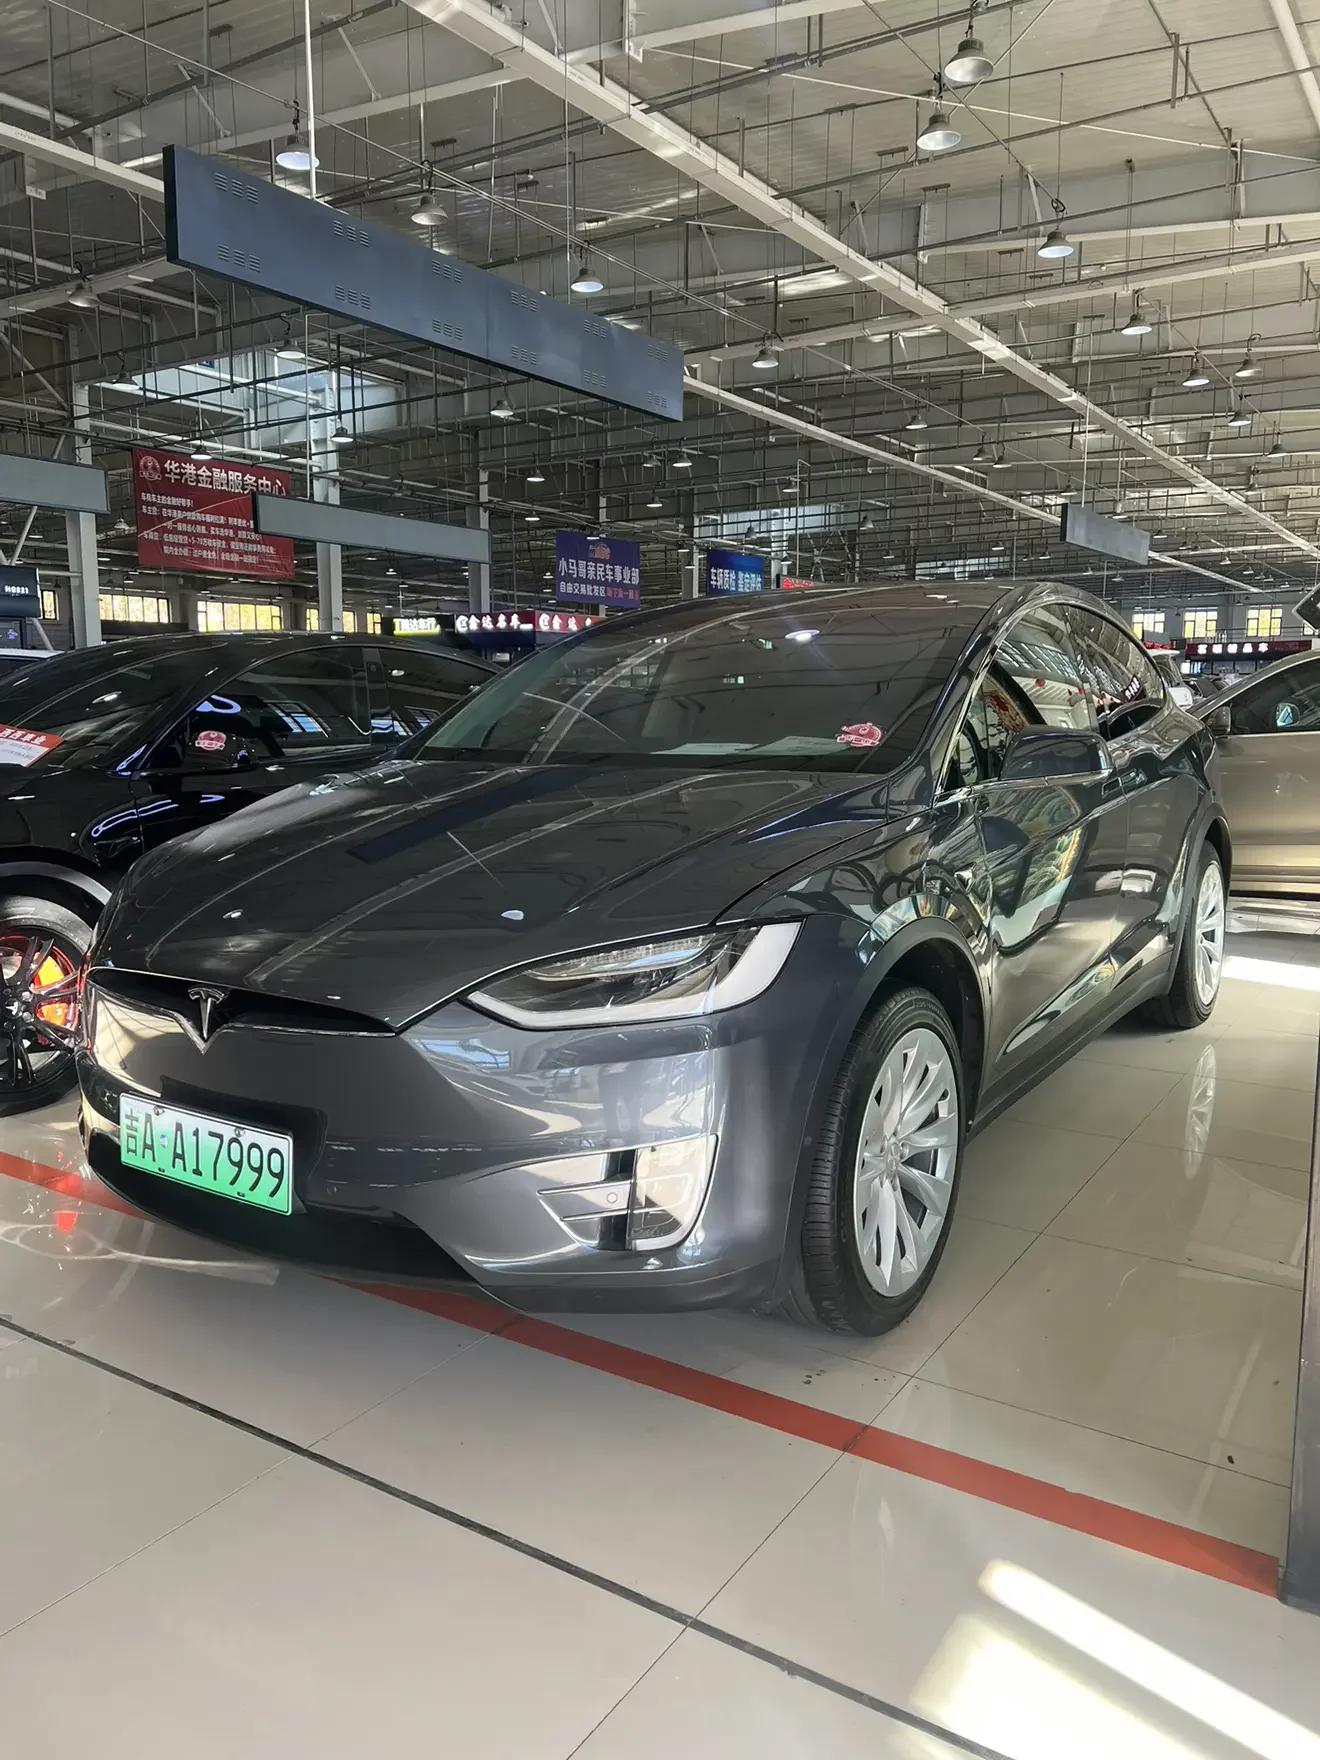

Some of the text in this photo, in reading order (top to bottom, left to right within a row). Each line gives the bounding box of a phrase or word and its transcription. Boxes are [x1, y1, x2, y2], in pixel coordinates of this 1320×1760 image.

[164, 460, 286, 495] 华港金融服务中心
[558, 557, 639, 585] 小马哥亲民车事业部
[710, 567, 736, 591] 车辆质检
[738, 570, 762, 592] 鉴定评估
[559, 581, 606, 597] 自由交易批发区
[171, 1121, 285, 1199] A17999
